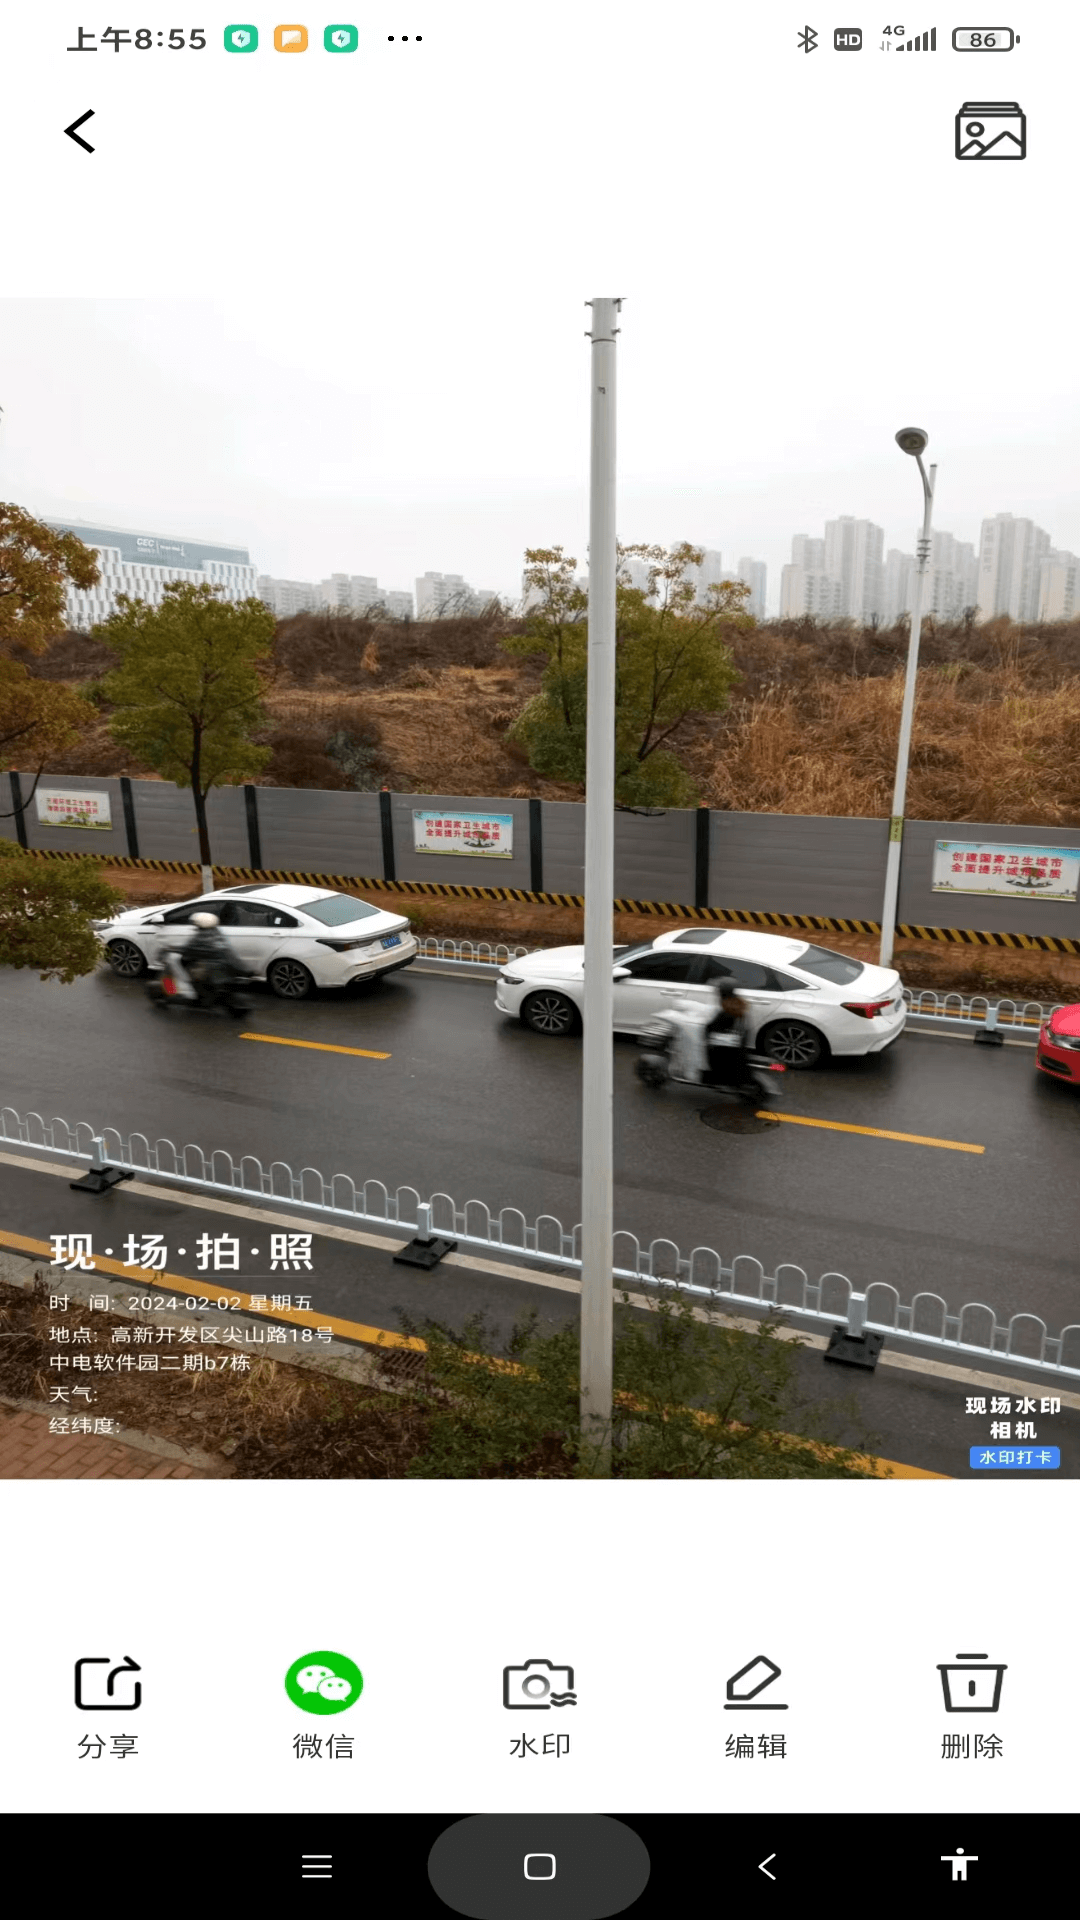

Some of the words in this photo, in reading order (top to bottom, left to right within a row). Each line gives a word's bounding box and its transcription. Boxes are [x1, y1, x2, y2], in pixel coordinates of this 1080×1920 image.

[66, 26, 207, 52] 上午8:55
[837, 33, 861, 46] HD
[882, 25, 905, 36] 4G
[970, 33, 996, 47] 86
[136, 538, 155, 547] CEC
[425, 820, 501, 831] 创建国家卫生城市
[952, 852, 1063, 868] 创建国家卫生城市
[77, 1733, 139, 1759] 分享
[292, 1733, 355, 1759] 微信
[509, 1732, 570, 1758] 水印
[725, 1733, 787, 1759] 编辑
[941, 1733, 1003, 1759] 删除
